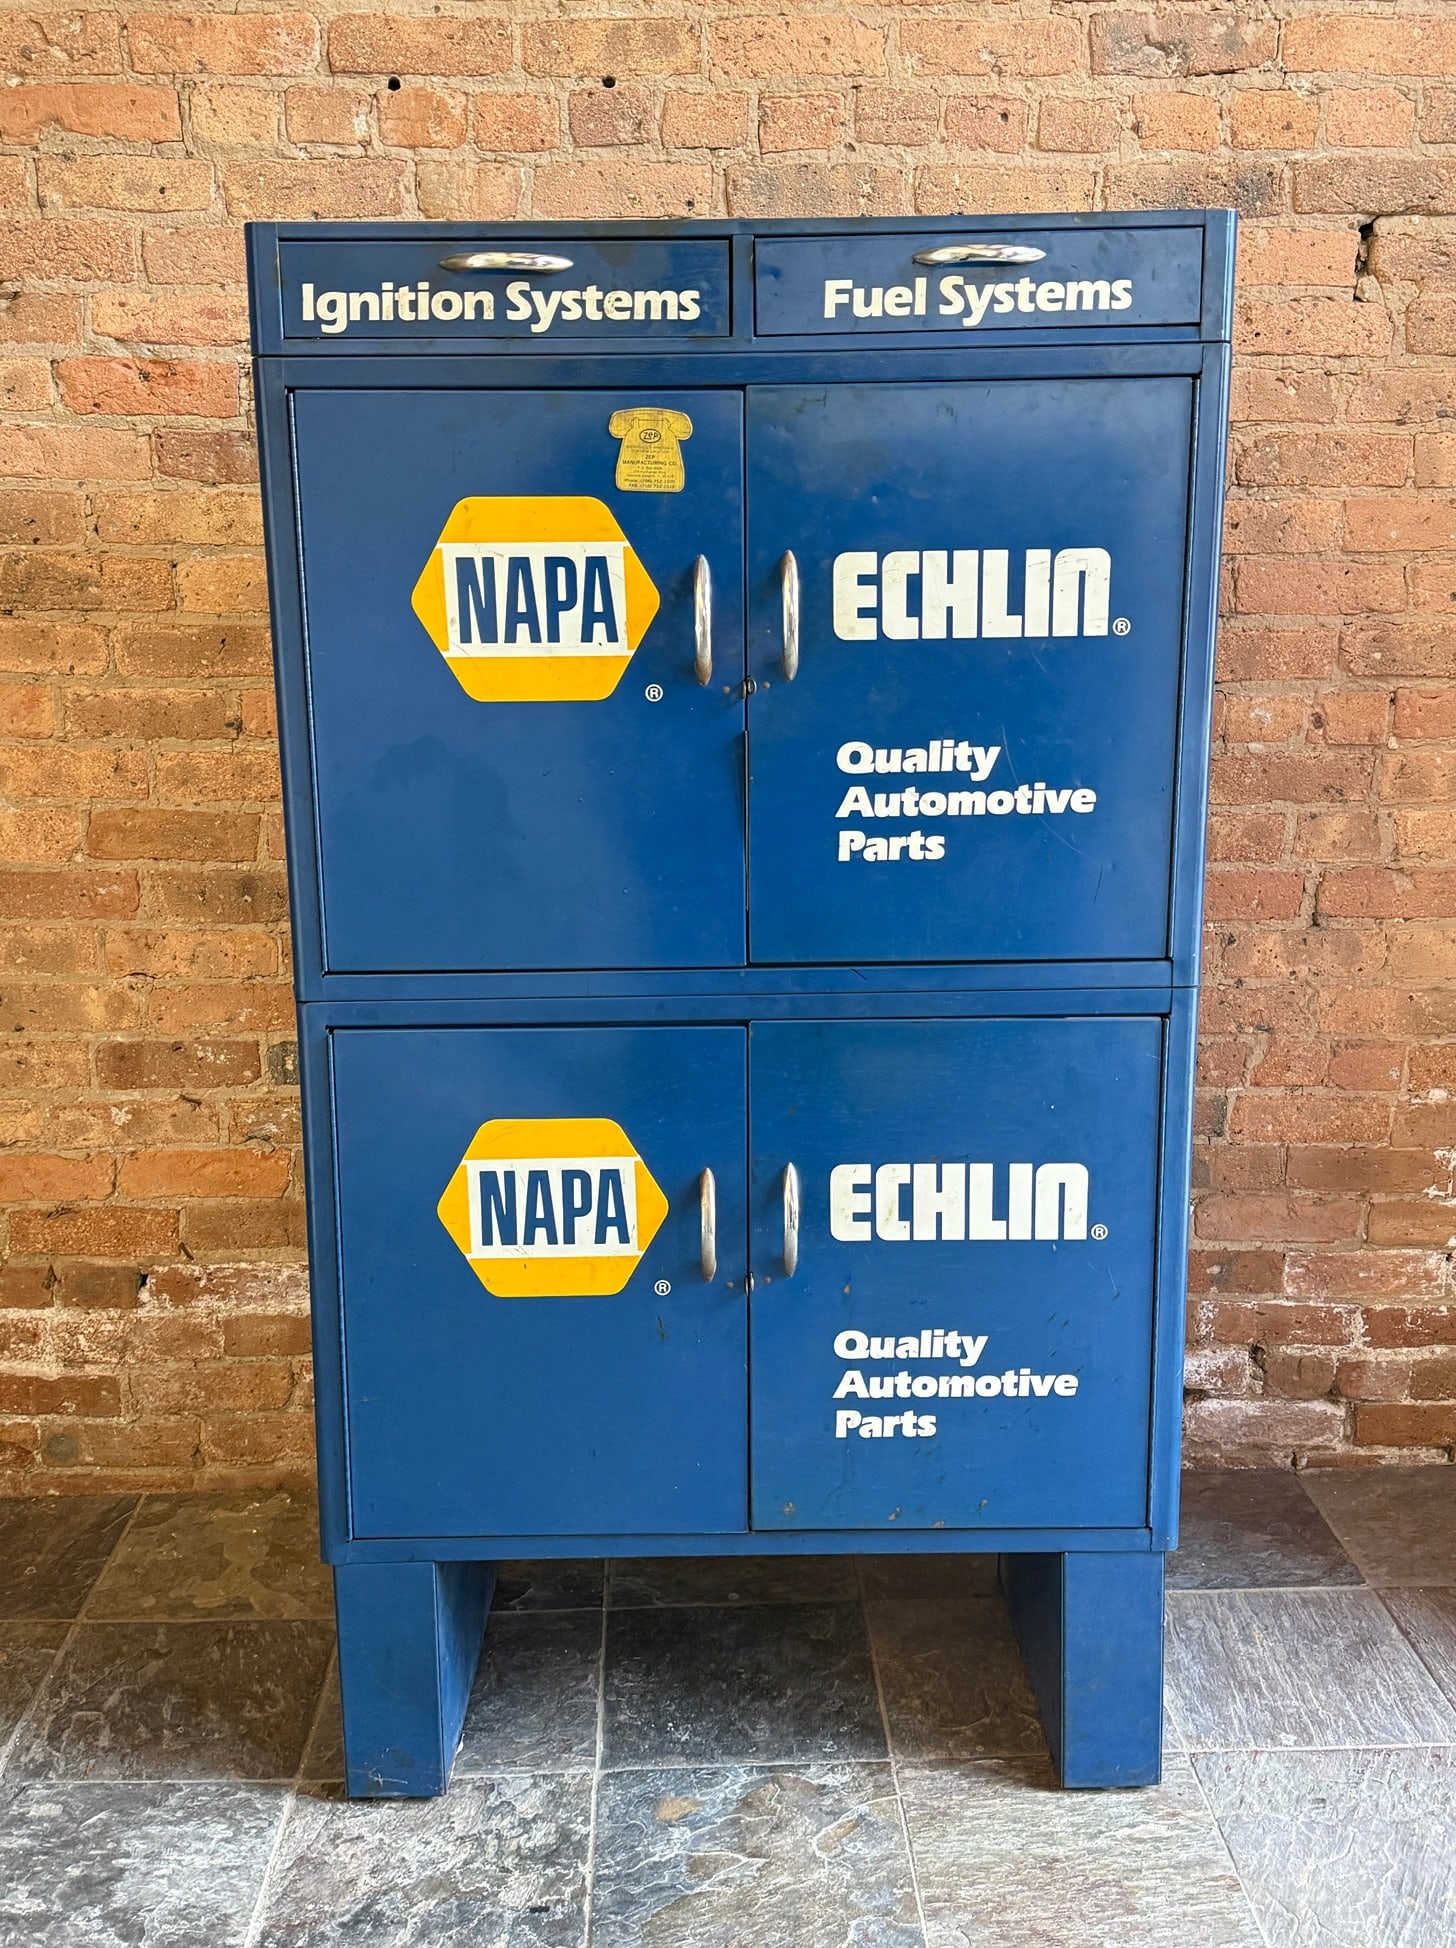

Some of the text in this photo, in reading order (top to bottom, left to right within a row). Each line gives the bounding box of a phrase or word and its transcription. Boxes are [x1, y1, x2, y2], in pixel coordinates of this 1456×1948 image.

[302, 281, 701, 334] Ignition Systems
[823, 276, 1133, 327] Fuel Systems
[455, 556, 620, 645] NAPA
[832, 548, 1111, 640] ECHLIN
[836, 740, 1001, 782] Quality
[835, 783, 1097, 818] Automotive
[838, 831, 946, 862] Parts
[479, 1169, 630, 1246] NAPA
[829, 1163, 1089, 1241] ECHLIN
[833, 1329, 988, 1367] Quality
[833, 1368, 1079, 1399] Automotive
[835, 1410, 937, 1439] Parts
